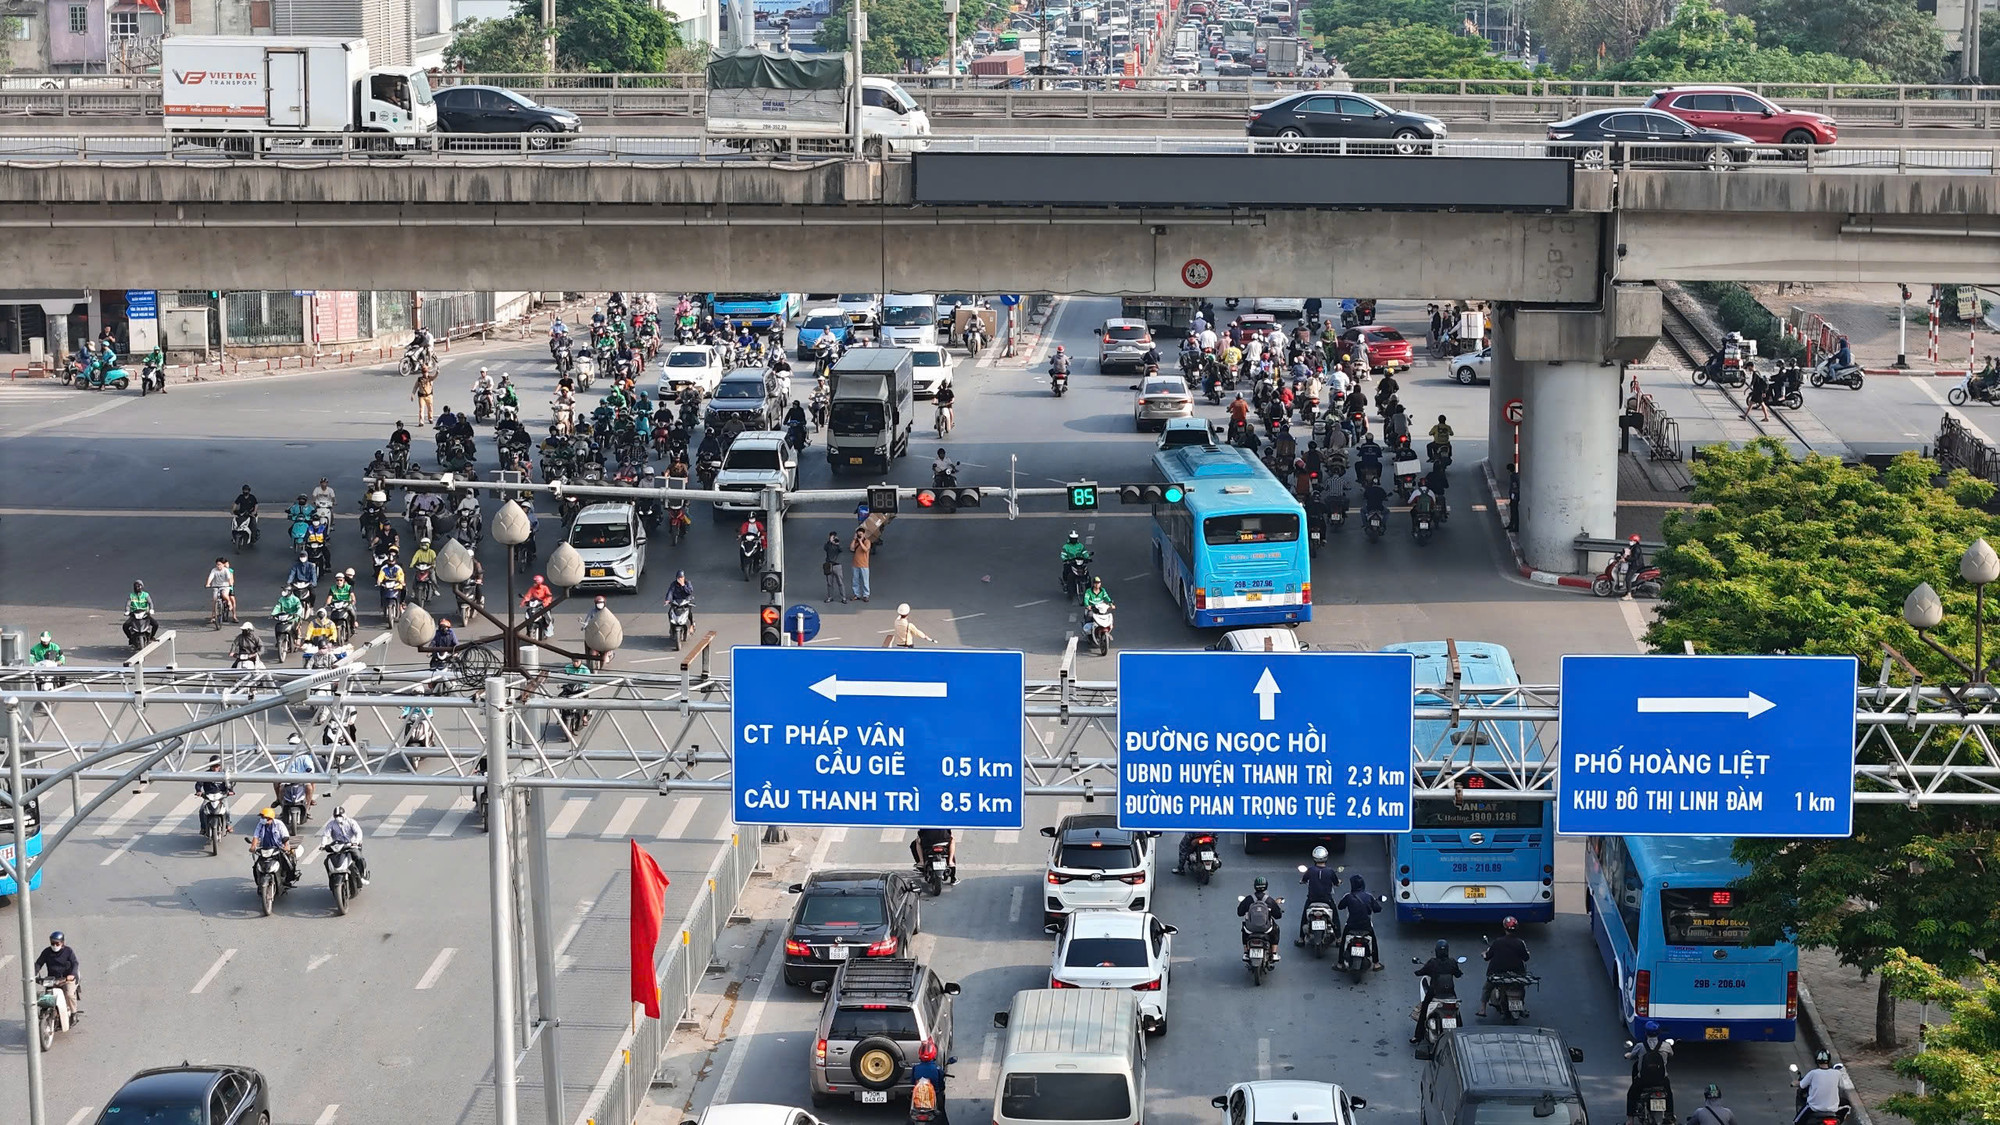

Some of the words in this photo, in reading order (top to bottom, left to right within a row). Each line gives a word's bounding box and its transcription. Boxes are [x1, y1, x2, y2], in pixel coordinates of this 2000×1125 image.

[1074, 488, 1095, 506] 85
[744, 725, 774, 744] CT
[785, 719, 849, 746] PHÁP
[857, 721, 905, 747] VÂN
[1125, 725, 1209, 752] ĐƯỜNG
[1216, 732, 1281, 756] NGỌC
[1288, 723, 1326, 753] HỒI
[815, 747, 861, 775] CẦU
[868, 751, 906, 776] GIẼ
[978, 757, 1013, 778] km
[1126, 763, 1172, 783] UBND
[1179, 759, 1234, 788] HUYỆN
[1241, 763, 1298, 784] THANH
[1305, 759, 1332, 785] TRÌ
[1347, 765, 1373, 788] 2,3
[1378, 765, 1405, 786] km
[1574, 745, 1624, 774] PHỐ
[1629, 749, 1712, 774] HOÀNG
[1718, 749, 1771, 780] LIỆT
[744, 780, 790, 809] CẦU
[797, 789, 877, 811] THANH
[884, 787, 920, 812] TRÌ
[978, 792, 1012, 813] km
[1125, 789, 1184, 815] ĐƯỜNG
[1190, 795, 1234, 816] PHAN
[1240, 795, 1298, 820] TRỌNG
[1346, 796, 1372, 819] 2,6
[1378, 796, 1404, 817] km
[1573, 789, 1608, 810] KHU
[1615, 786, 1638, 810] ĐÔ
[1645, 790, 1673, 814] THỊ
[1679, 790, 1719, 811] LINH
[1725, 785, 1763, 811] ĐÀM
[1795, 791, 1802, 811] 1
[1808, 791, 1835, 812] km
[1471, 812, 1517, 821] 1900.1296
[1452, 863, 1468, 873] 29B
[1475, 863, 1502, 873] 210.89
[1694, 979, 1710, 989] 29B
[1717, 979, 1746, 989] 206.04
